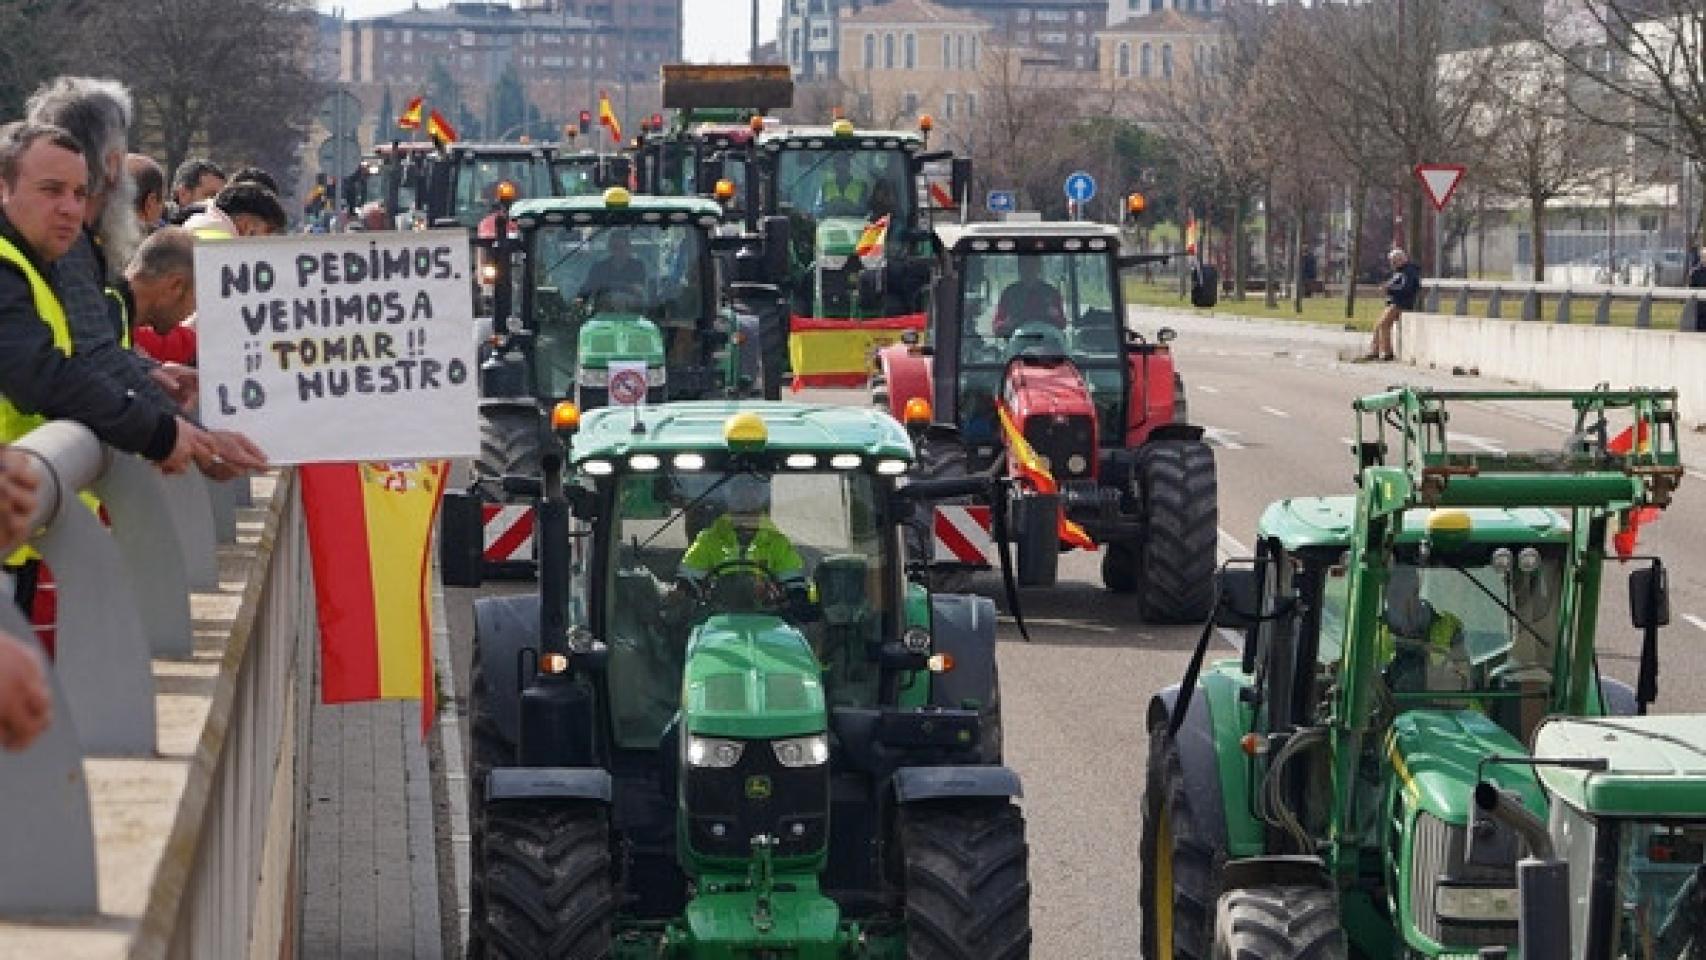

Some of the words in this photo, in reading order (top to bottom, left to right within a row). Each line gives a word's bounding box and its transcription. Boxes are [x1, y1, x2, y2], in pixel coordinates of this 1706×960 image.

[221, 261, 274, 298] NO
[411, 290, 432, 321] A
[217, 378, 265, 415] LO
[297, 357, 467, 401] NUESTRO
